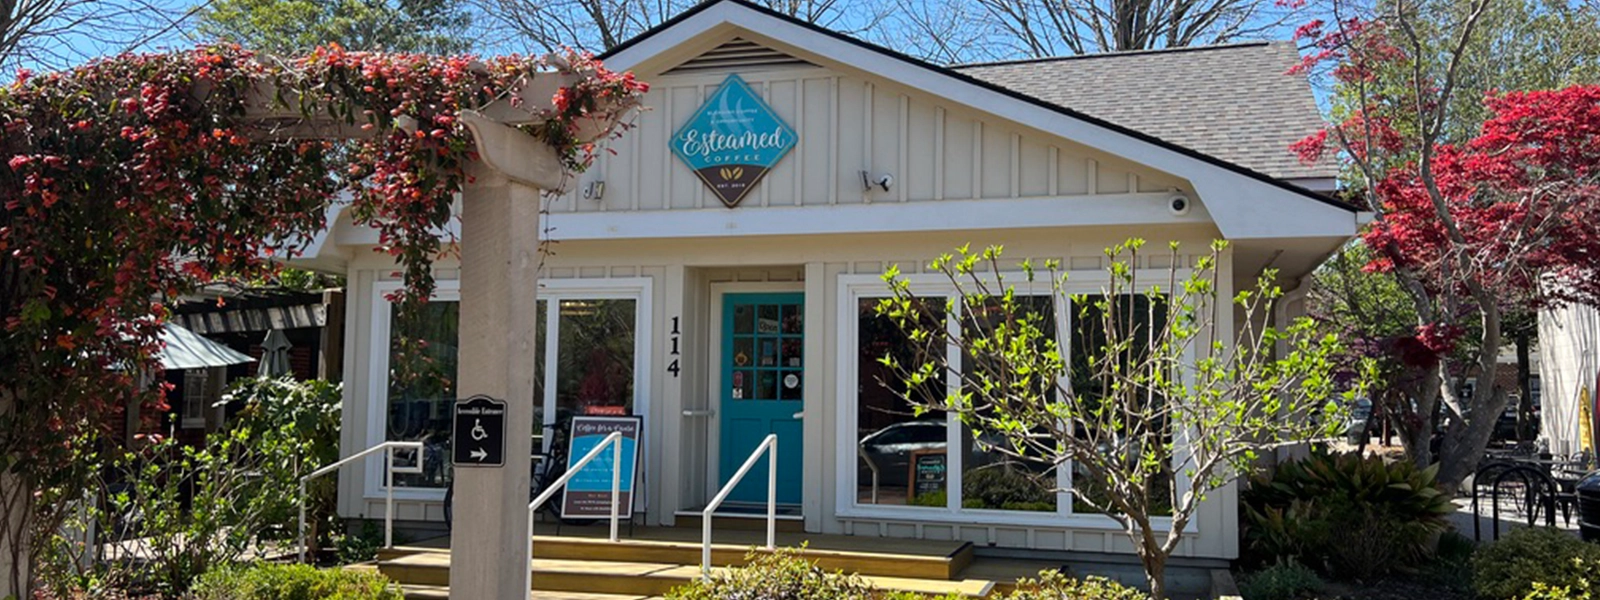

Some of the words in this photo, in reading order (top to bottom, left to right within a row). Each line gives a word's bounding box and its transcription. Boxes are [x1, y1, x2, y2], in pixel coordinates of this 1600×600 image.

[681, 127, 785, 156] Esteamed
[704, 154, 760, 163] COFFEE
[667, 315, 681, 378] 114
